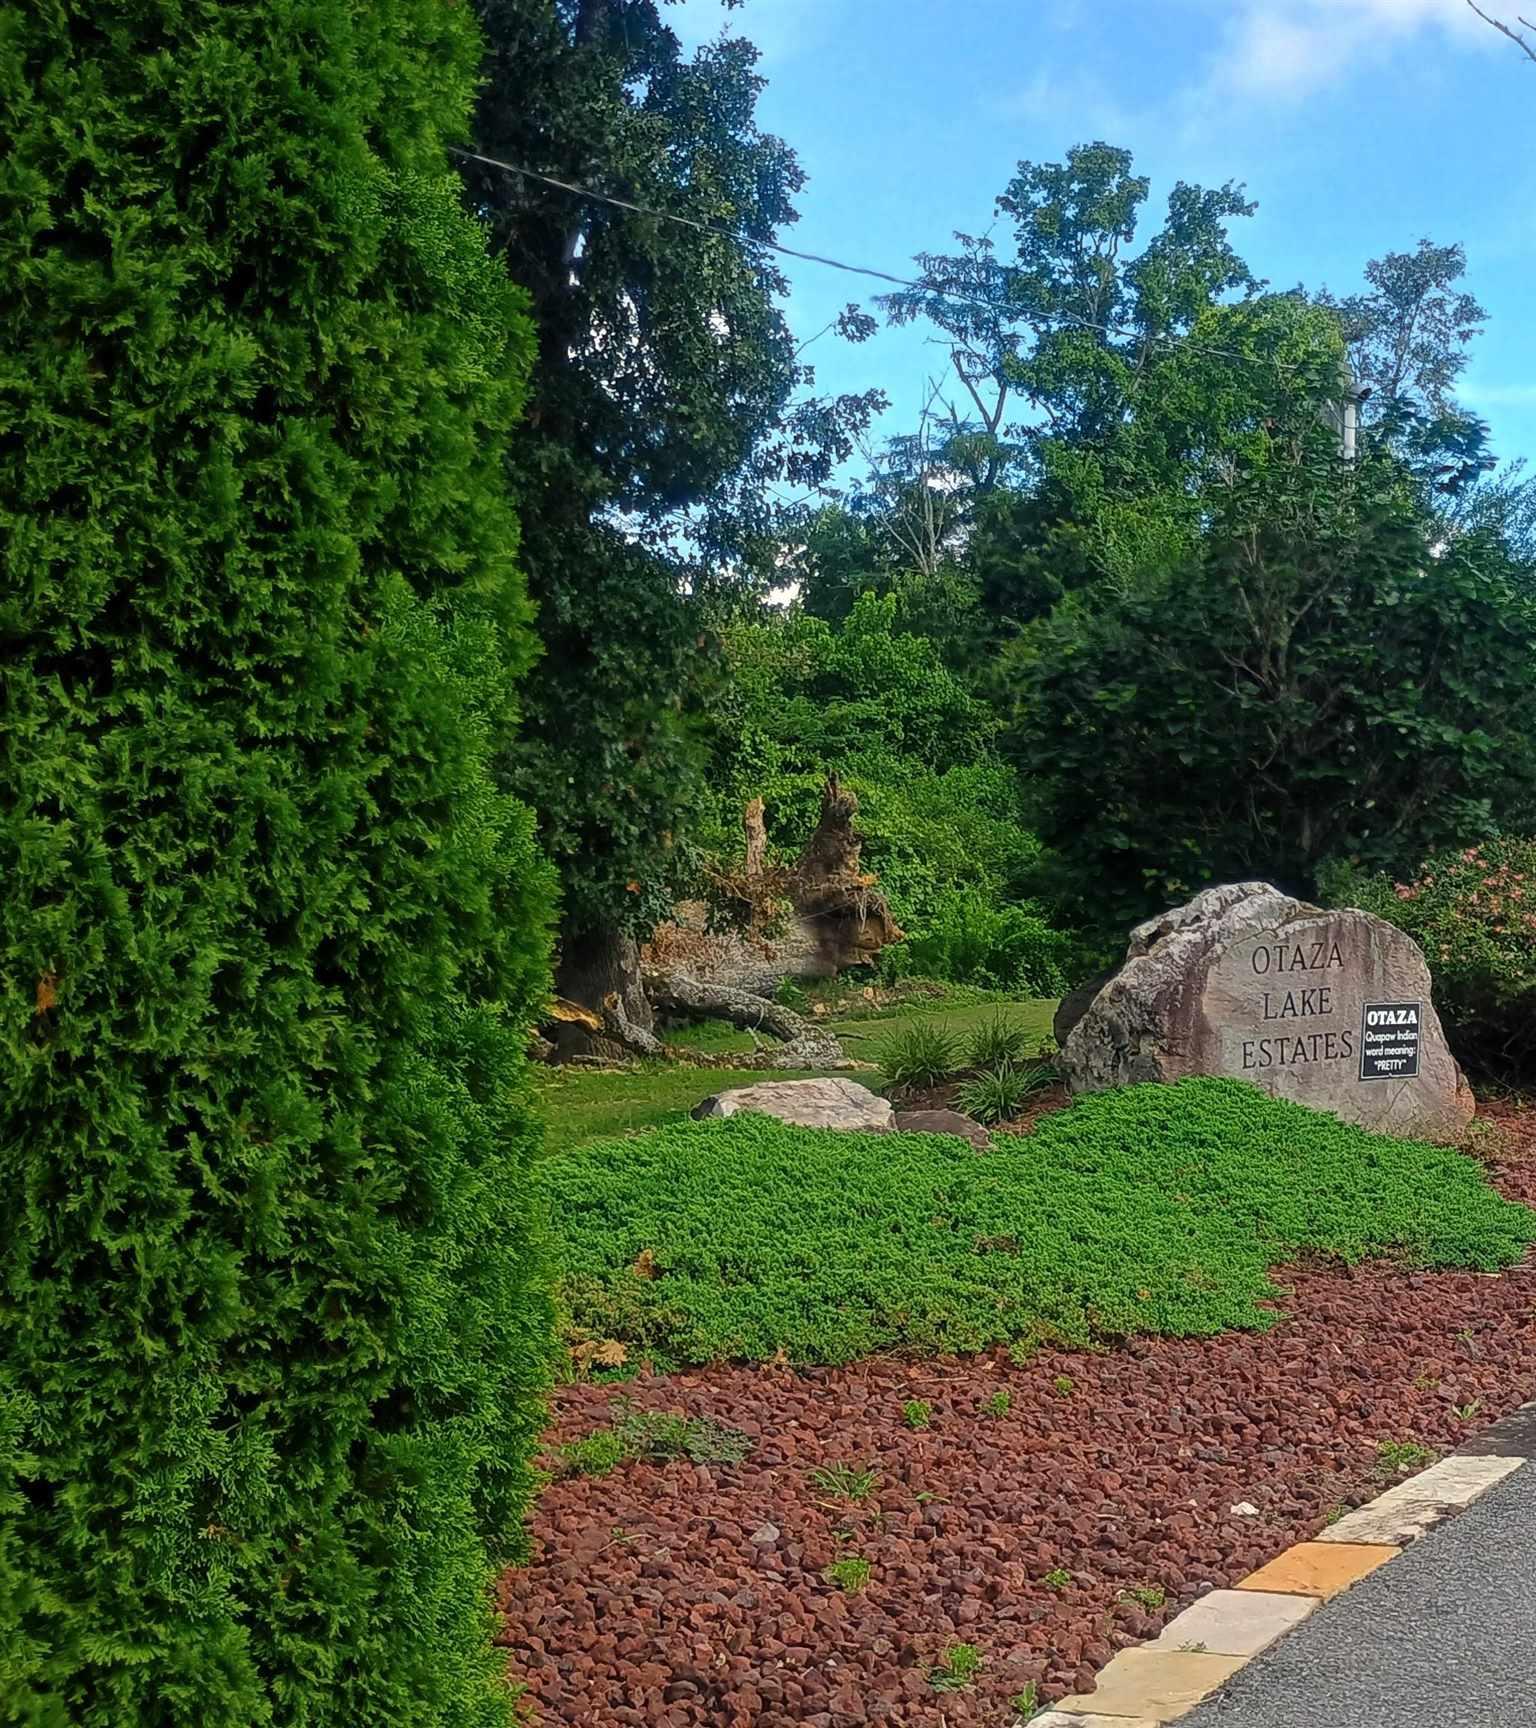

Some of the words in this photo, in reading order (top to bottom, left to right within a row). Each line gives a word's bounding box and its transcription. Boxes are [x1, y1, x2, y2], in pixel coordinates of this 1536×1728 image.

[1252, 942, 1343, 974] OTAZA
[1263, 987, 1333, 1020] LAKE
[1367, 1010, 1418, 1026] OTAZA
[1366, 1031, 1395, 1043] Quapaw
[1397, 1030, 1418, 1041] Indian
[1242, 1031, 1353, 1069] ESTATES
[1366, 1045, 1383, 1056] word
[1384, 1044, 1416, 1057] meaning:
